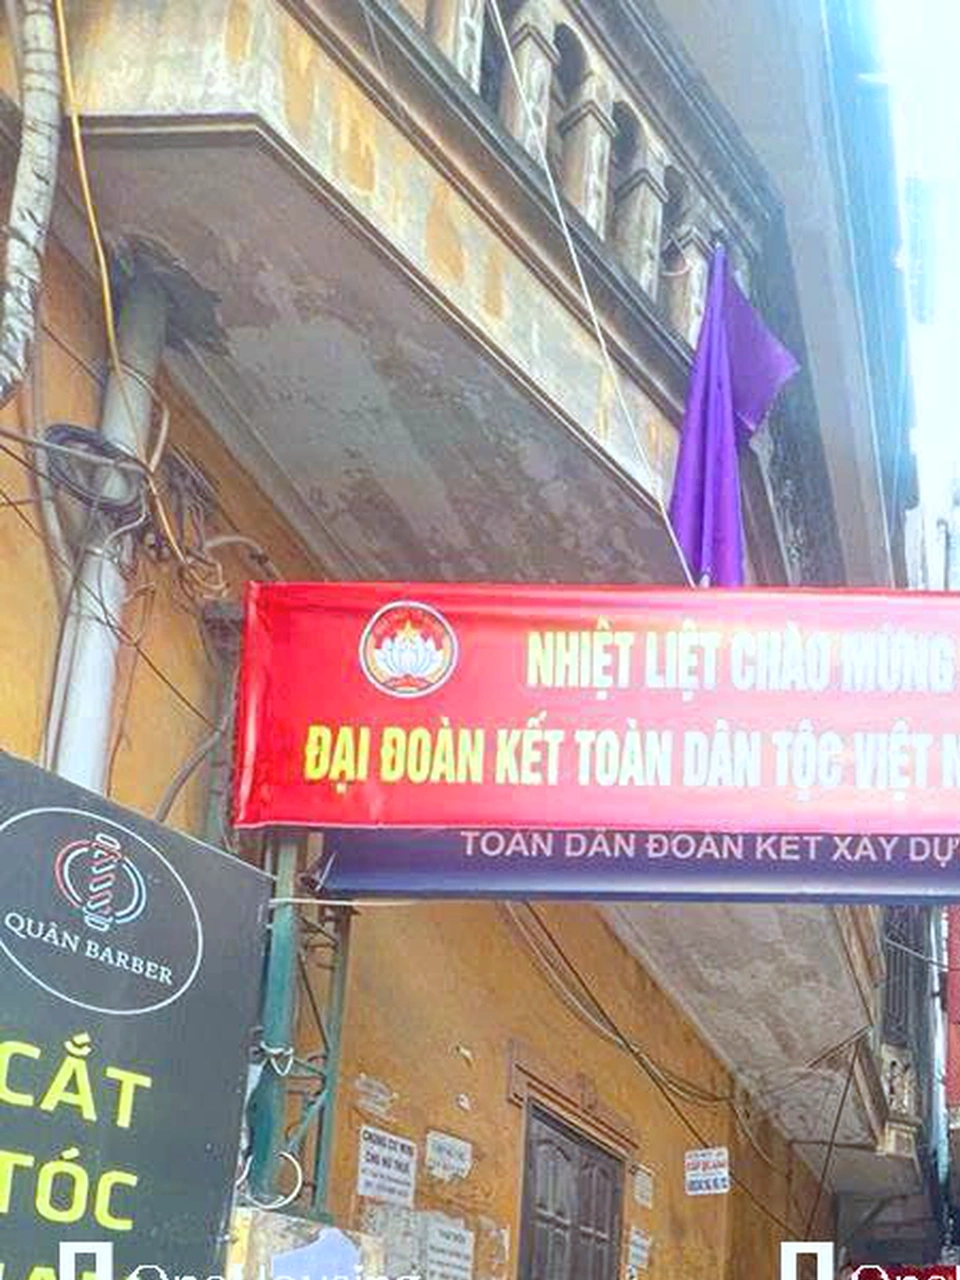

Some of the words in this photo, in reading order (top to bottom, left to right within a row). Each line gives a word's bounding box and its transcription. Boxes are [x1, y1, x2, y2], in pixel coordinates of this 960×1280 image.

[526, 614, 634, 700] NHIỆT
[645, 618, 718, 702] LIỆT
[304, 725, 371, 794] ĐẠI
[379, 716, 485, 784] ĐOÀN
[495, 711, 564, 786] KẾT
[574, 718, 673, 787] TOÀN
[682, 719, 762, 787] DÂN
[772, 719, 844, 802] TỘC
[853, 718, 932, 802] VIỆT
[4, 912, 81, 952] QUÂN
[85, 939, 174, 985] BARBER
[0, 1032, 153, 1128] CẮT
[0, 1147, 138, 1231] TÓC
